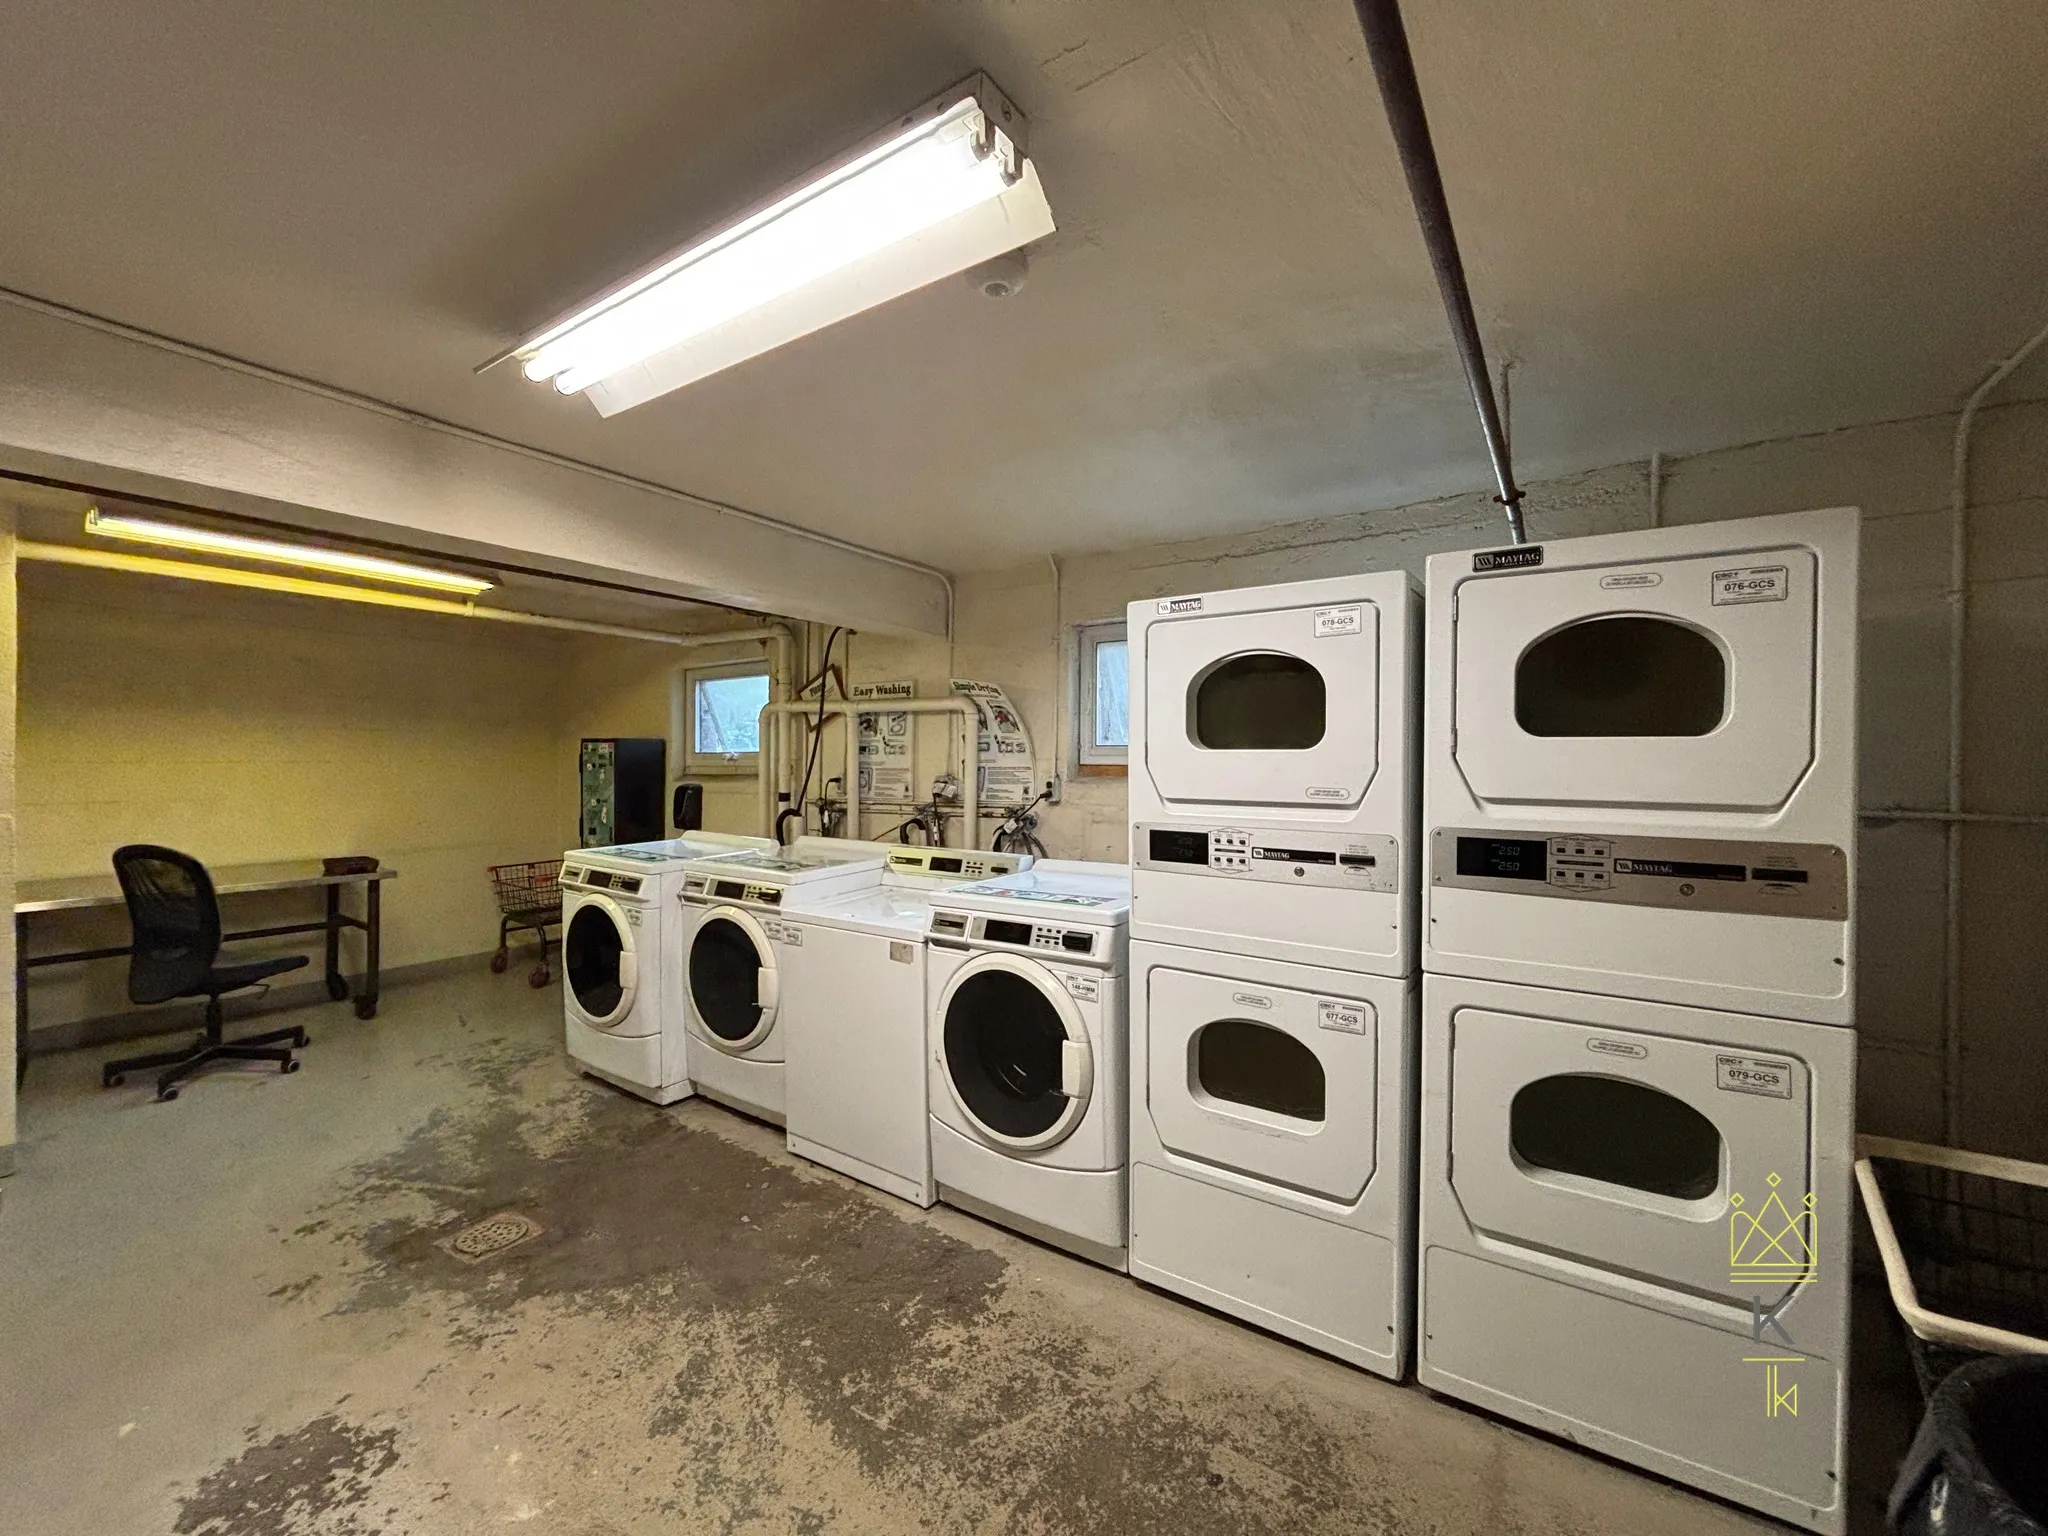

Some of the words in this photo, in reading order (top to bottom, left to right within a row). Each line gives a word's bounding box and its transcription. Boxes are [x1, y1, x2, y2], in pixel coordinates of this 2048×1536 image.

[1495, 552, 1540, 565] MAYTAG
[1724, 579, 1776, 591] 076-GCS
[1171, 600, 1201, 611] MAYTAG
[1321, 617, 1354, 627] 078-GCS
[853, 686, 874, 698] Easy
[876, 683, 911, 697] Washing
[953, 681, 975, 692] Simple
[976, 683, 1002, 696] Drying
[1264, 851, 1290, 859] MAYTAG
[1632, 863, 1673, 873] MAYTAG
[1325, 1012, 1358, 1024] 077-GCS
[1728, 1069, 1780, 1084] 079-GCS
